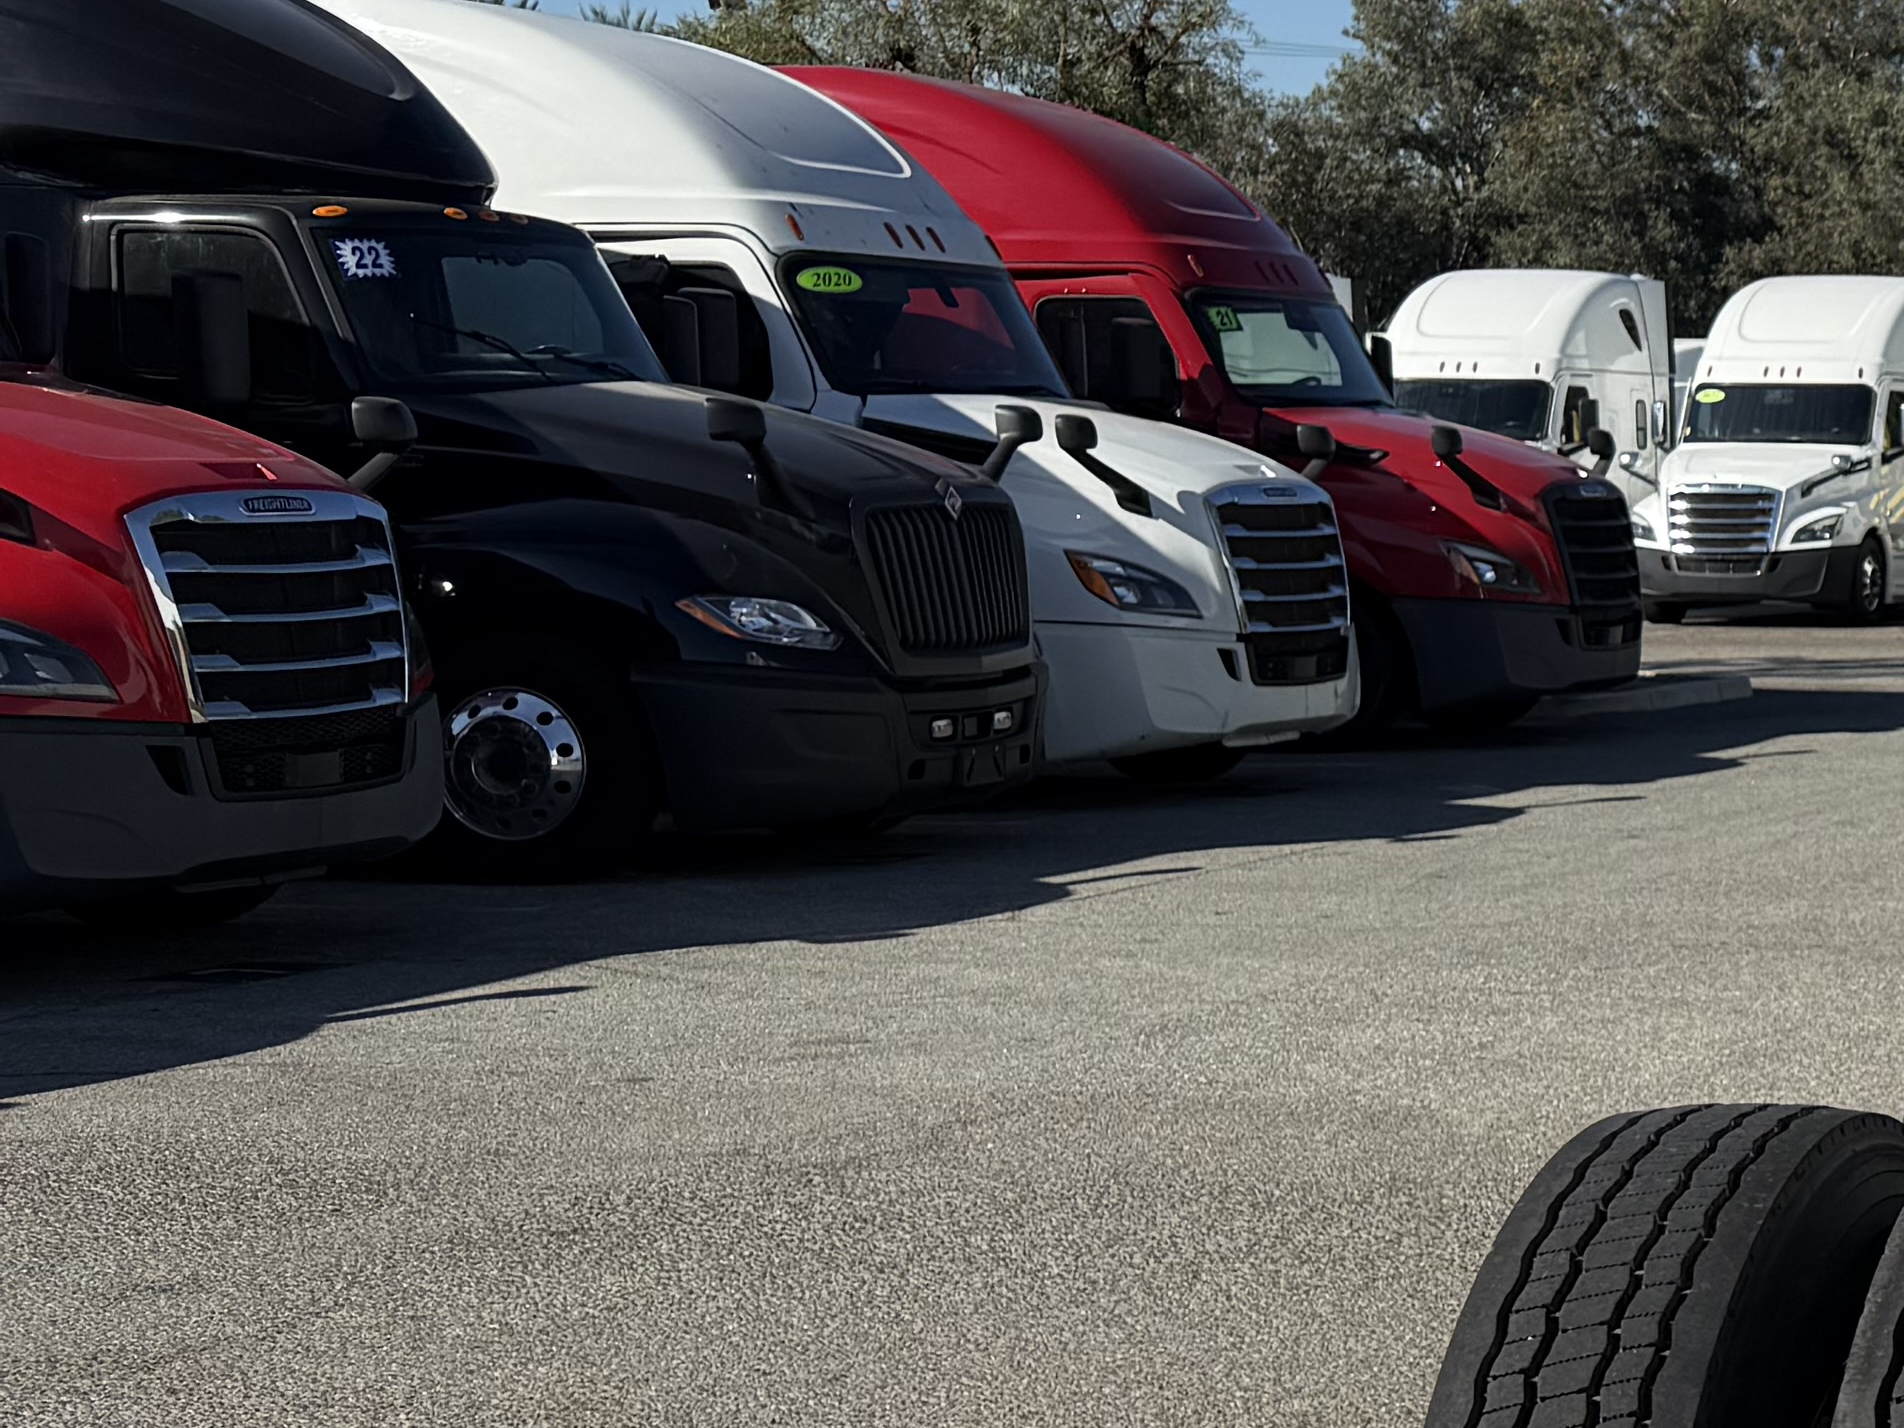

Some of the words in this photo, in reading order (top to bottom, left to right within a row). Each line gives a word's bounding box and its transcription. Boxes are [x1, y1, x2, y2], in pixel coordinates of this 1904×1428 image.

[350, 245, 385, 270] 22
[811, 271, 853, 288] 2020
[1215, 309, 1234, 327] 21
